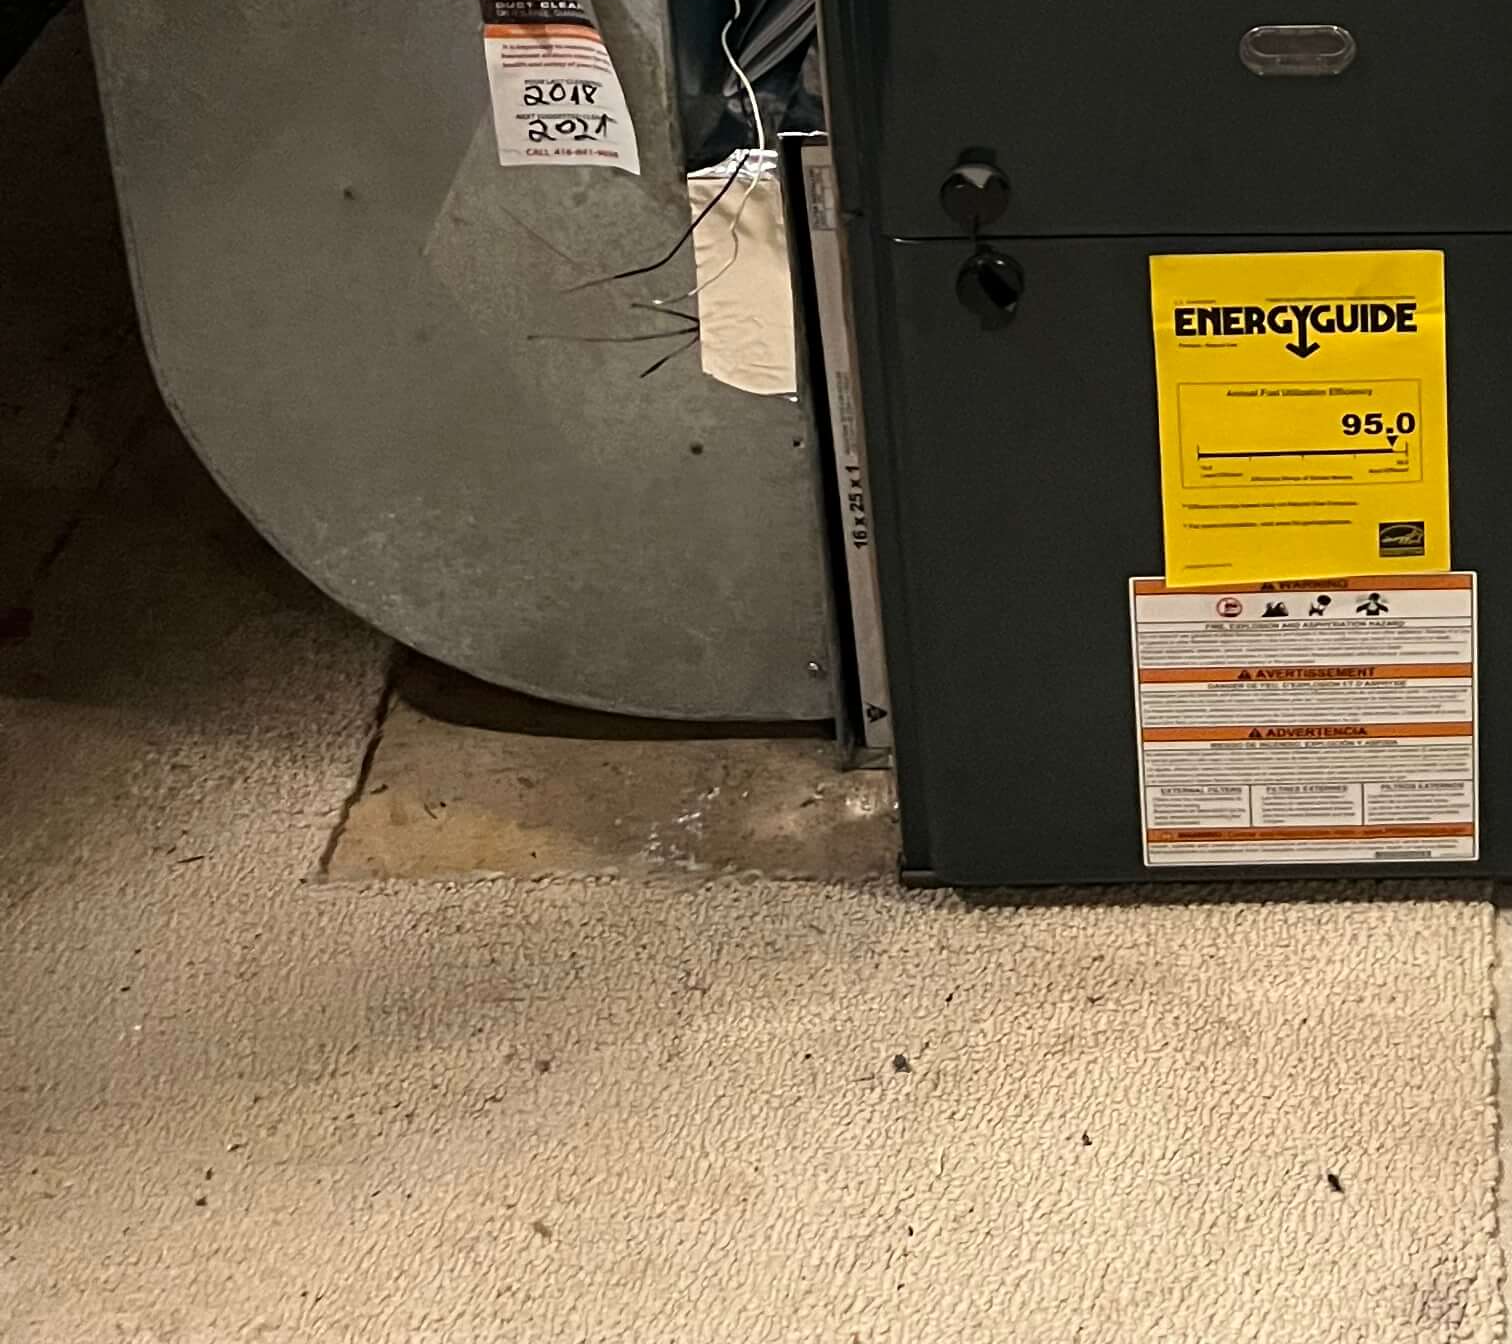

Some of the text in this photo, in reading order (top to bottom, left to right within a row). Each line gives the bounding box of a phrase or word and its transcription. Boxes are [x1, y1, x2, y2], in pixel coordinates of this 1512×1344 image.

[524, 83, 597, 106] 2018
[526, 148, 550, 157] CALL
[1174, 302, 1418, 340] ENERGYGUIDE
[1341, 412, 1416, 436] 95.0
[845, 464, 860, 473] 1
[850, 480, 862, 490] x
[848, 493, 865, 512] 25
[854, 518, 867, 527] x
[853, 529, 868, 549] 16
[1255, 667, 1376, 680] AVERTISSEMENT
[1265, 726, 1368, 738] ADVERTENCIA
